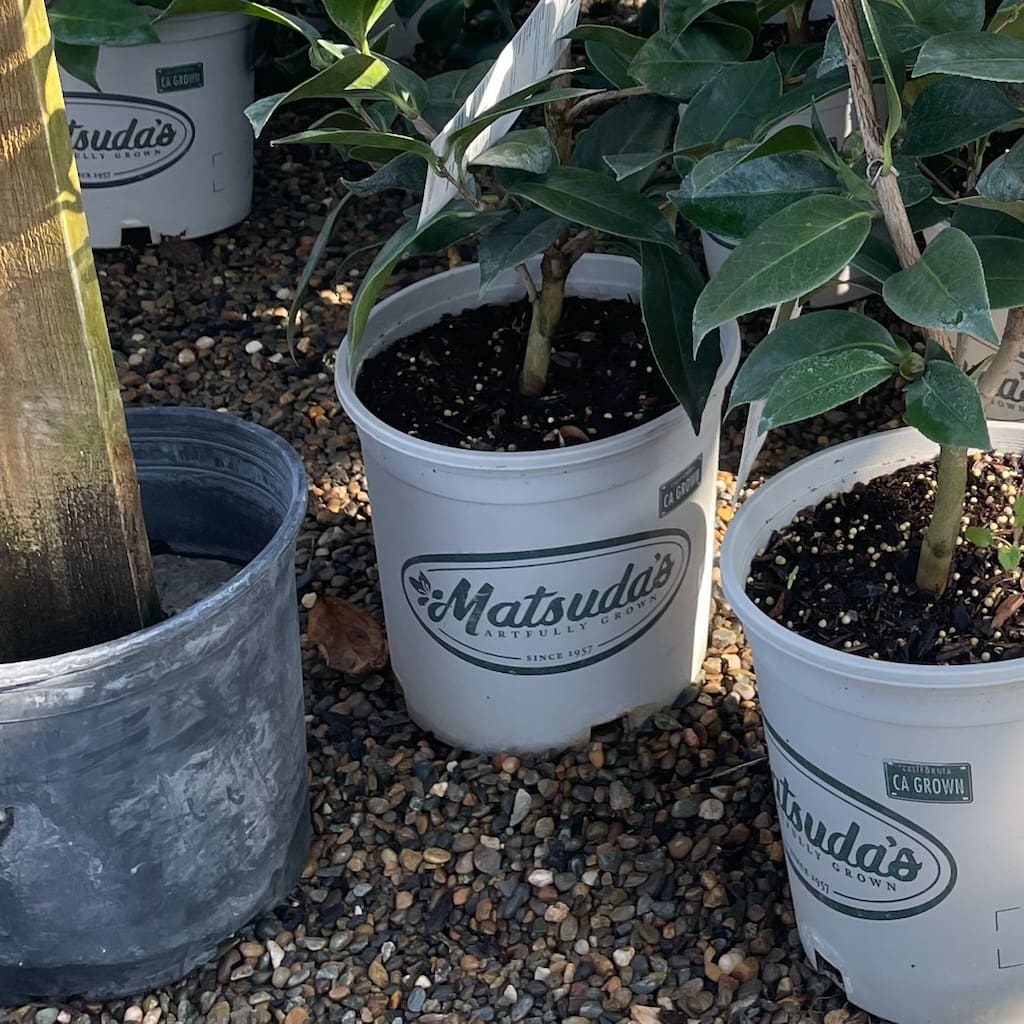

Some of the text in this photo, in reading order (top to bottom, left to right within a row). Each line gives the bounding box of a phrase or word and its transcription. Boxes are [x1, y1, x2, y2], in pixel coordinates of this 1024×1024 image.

[161, 76, 171, 88] CA
[68, 118, 177, 151] tsuda's
[115, 150, 161, 160] GROWN
[663, 491, 674, 507] CA
[427, 552, 675, 636] Matsuda's
[485, 595, 657, 638] ARTFULLY GROWN
[526, 645, 593, 662] SINCE 1957
[893, 775, 964, 795] CA GROWN
[775, 777, 922, 882] tsuda's
[832, 862, 897, 892] GROWN
